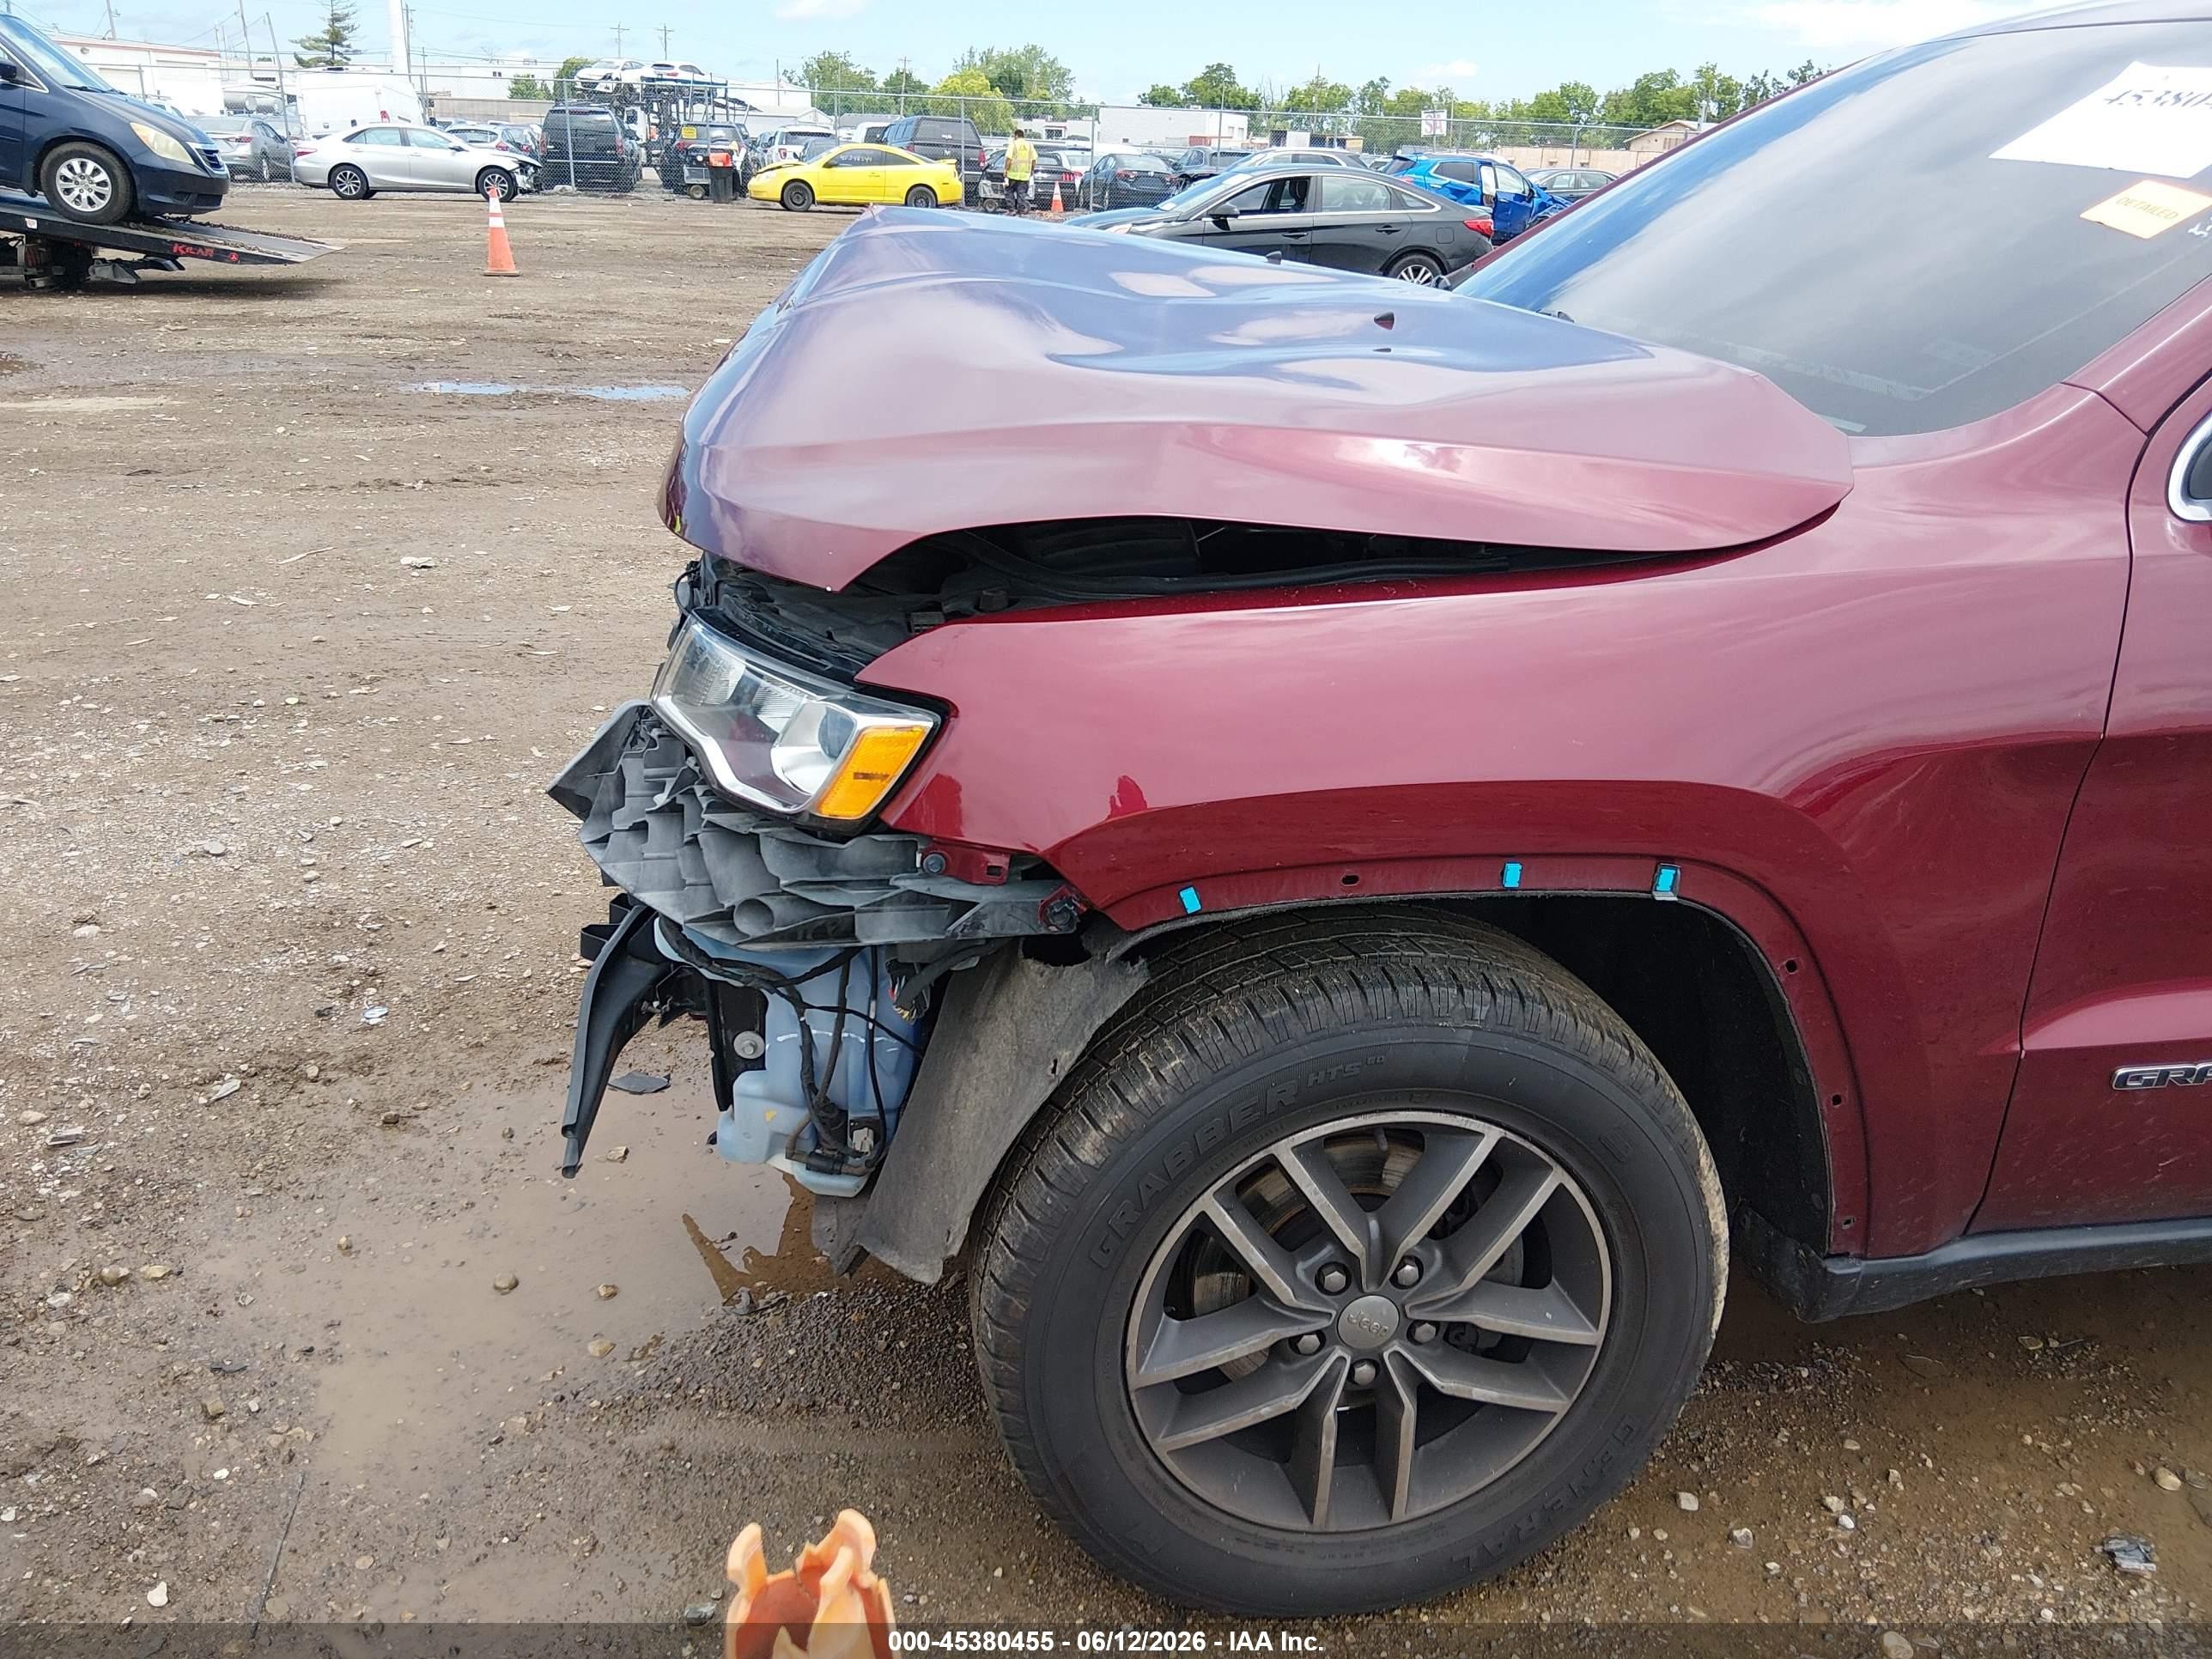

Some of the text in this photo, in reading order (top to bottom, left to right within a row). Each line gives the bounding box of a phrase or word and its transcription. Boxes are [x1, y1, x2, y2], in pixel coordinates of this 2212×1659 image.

[2115, 196, 2179, 220] DETAILED
[1086, 1079, 1299, 1272] GRABBER
[1347, 1310, 1389, 1337] Jeep
